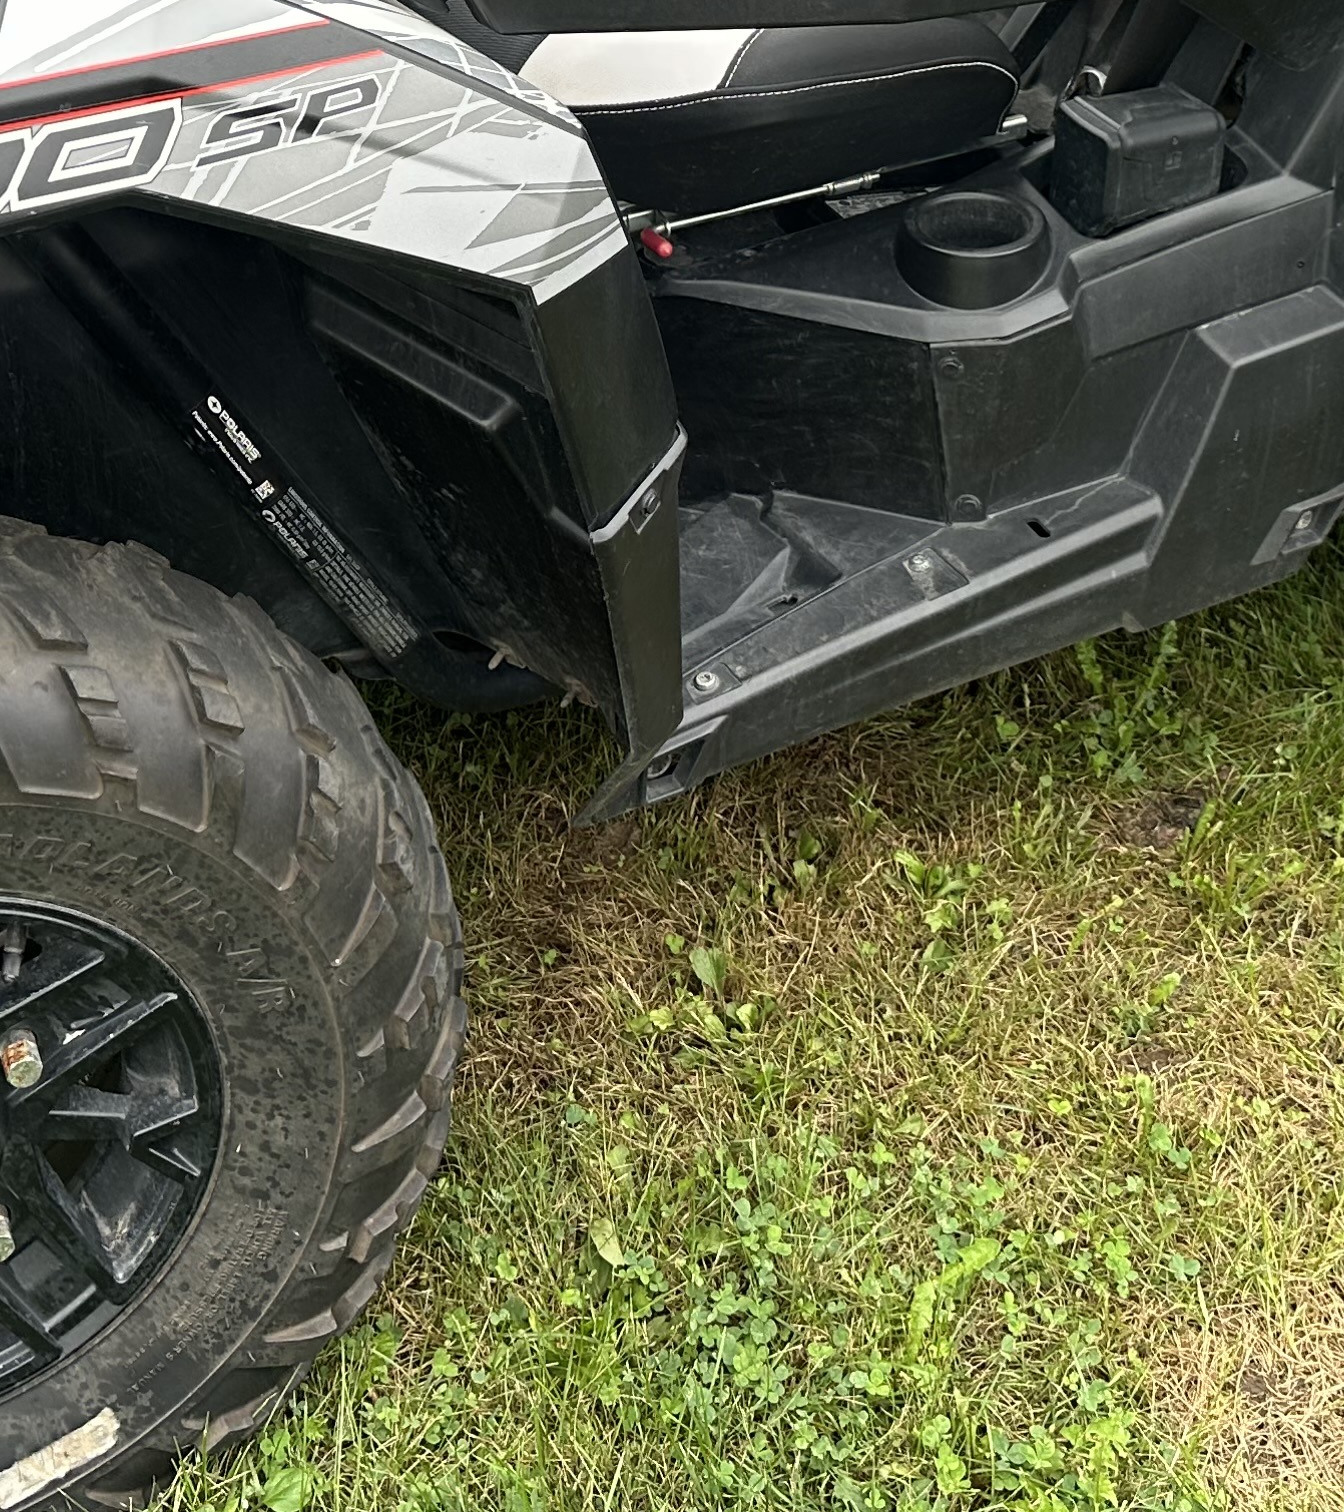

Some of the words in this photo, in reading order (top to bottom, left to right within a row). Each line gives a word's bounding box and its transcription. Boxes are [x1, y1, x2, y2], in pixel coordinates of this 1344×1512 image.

[191, 76, 382, 171] SP
[218, 409, 262, 460] POLARIS
[272, 521, 309, 559] POLARIS
